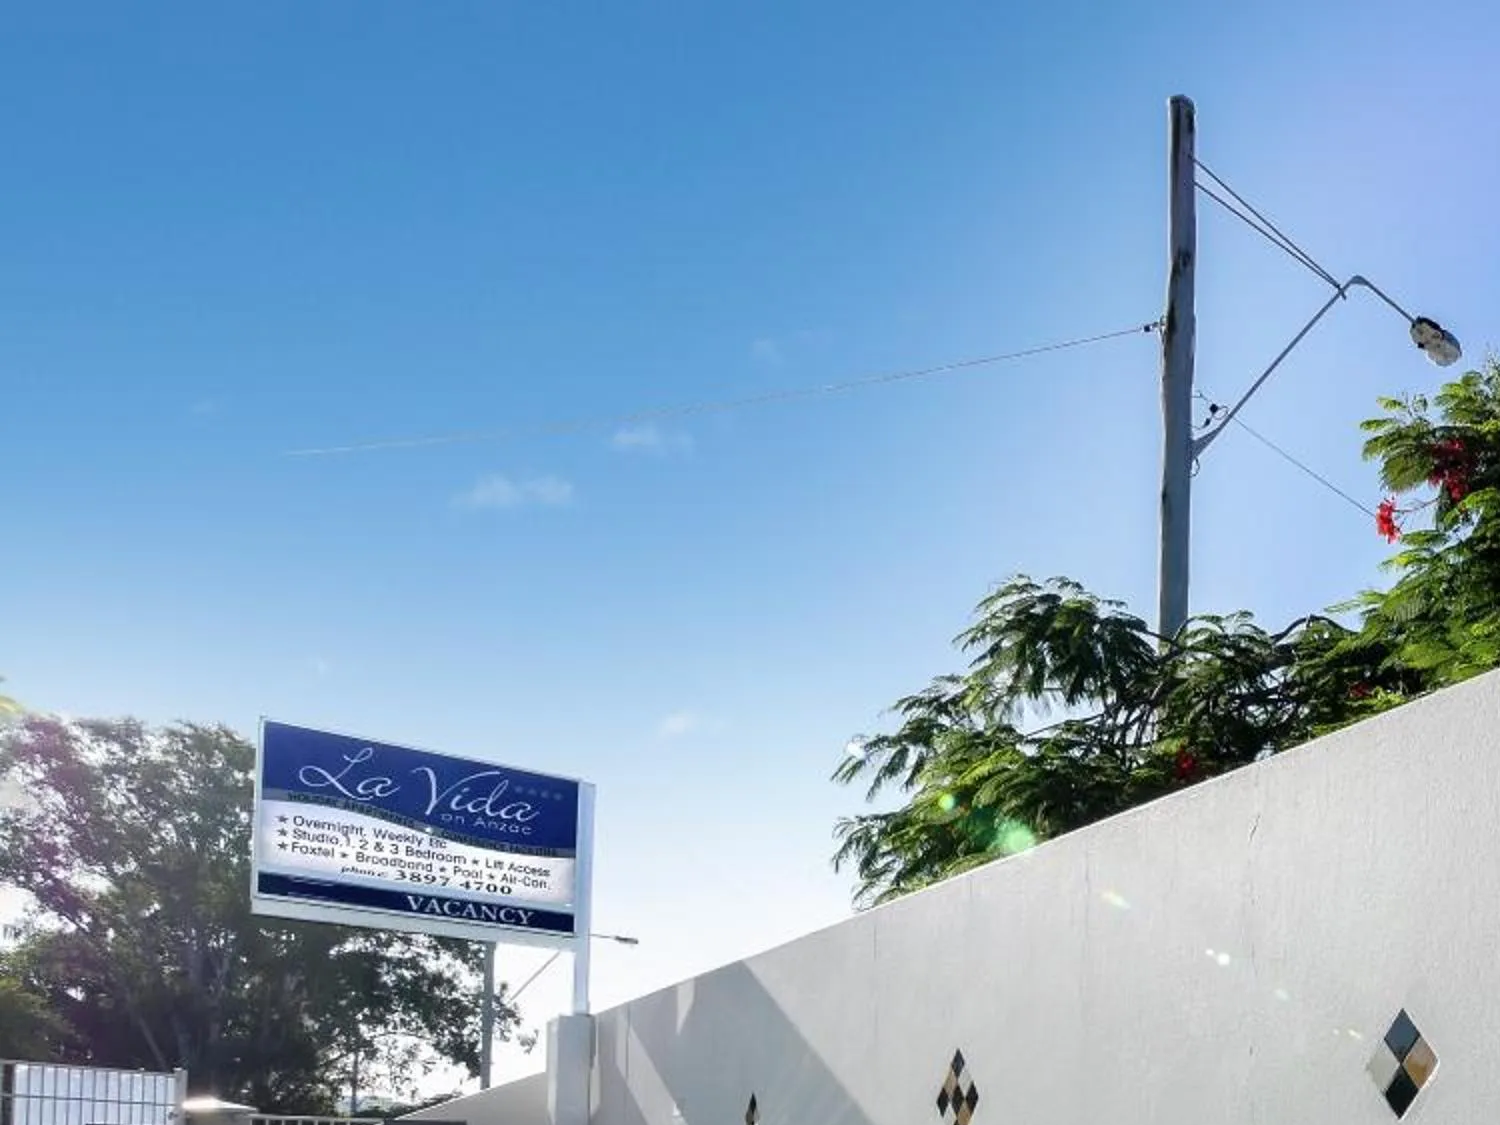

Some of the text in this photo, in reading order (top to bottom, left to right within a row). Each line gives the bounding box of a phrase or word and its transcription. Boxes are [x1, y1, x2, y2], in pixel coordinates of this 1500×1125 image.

[299, 747, 400, 800] La
[411, 766, 540, 822] Vida
[373, 828, 424, 847] Weekly
[441, 814, 533, 836] on Anzac
[291, 842, 335, 858] Foxtel
[355, 852, 433, 873] Broadband
[453, 865, 483, 880] Pool
[359, 839, 369, 850] 2
[374, 842, 384, 852] &
[390, 843, 399, 855] 3
[405, 845, 467, 864] Bedroom
[485, 857, 504, 870] Lift
[508, 862, 551, 877] Access
[395, 869, 450, 887] 3897
[459, 880, 513, 895] 4700
[407, 895, 535, 926] VACANCY
